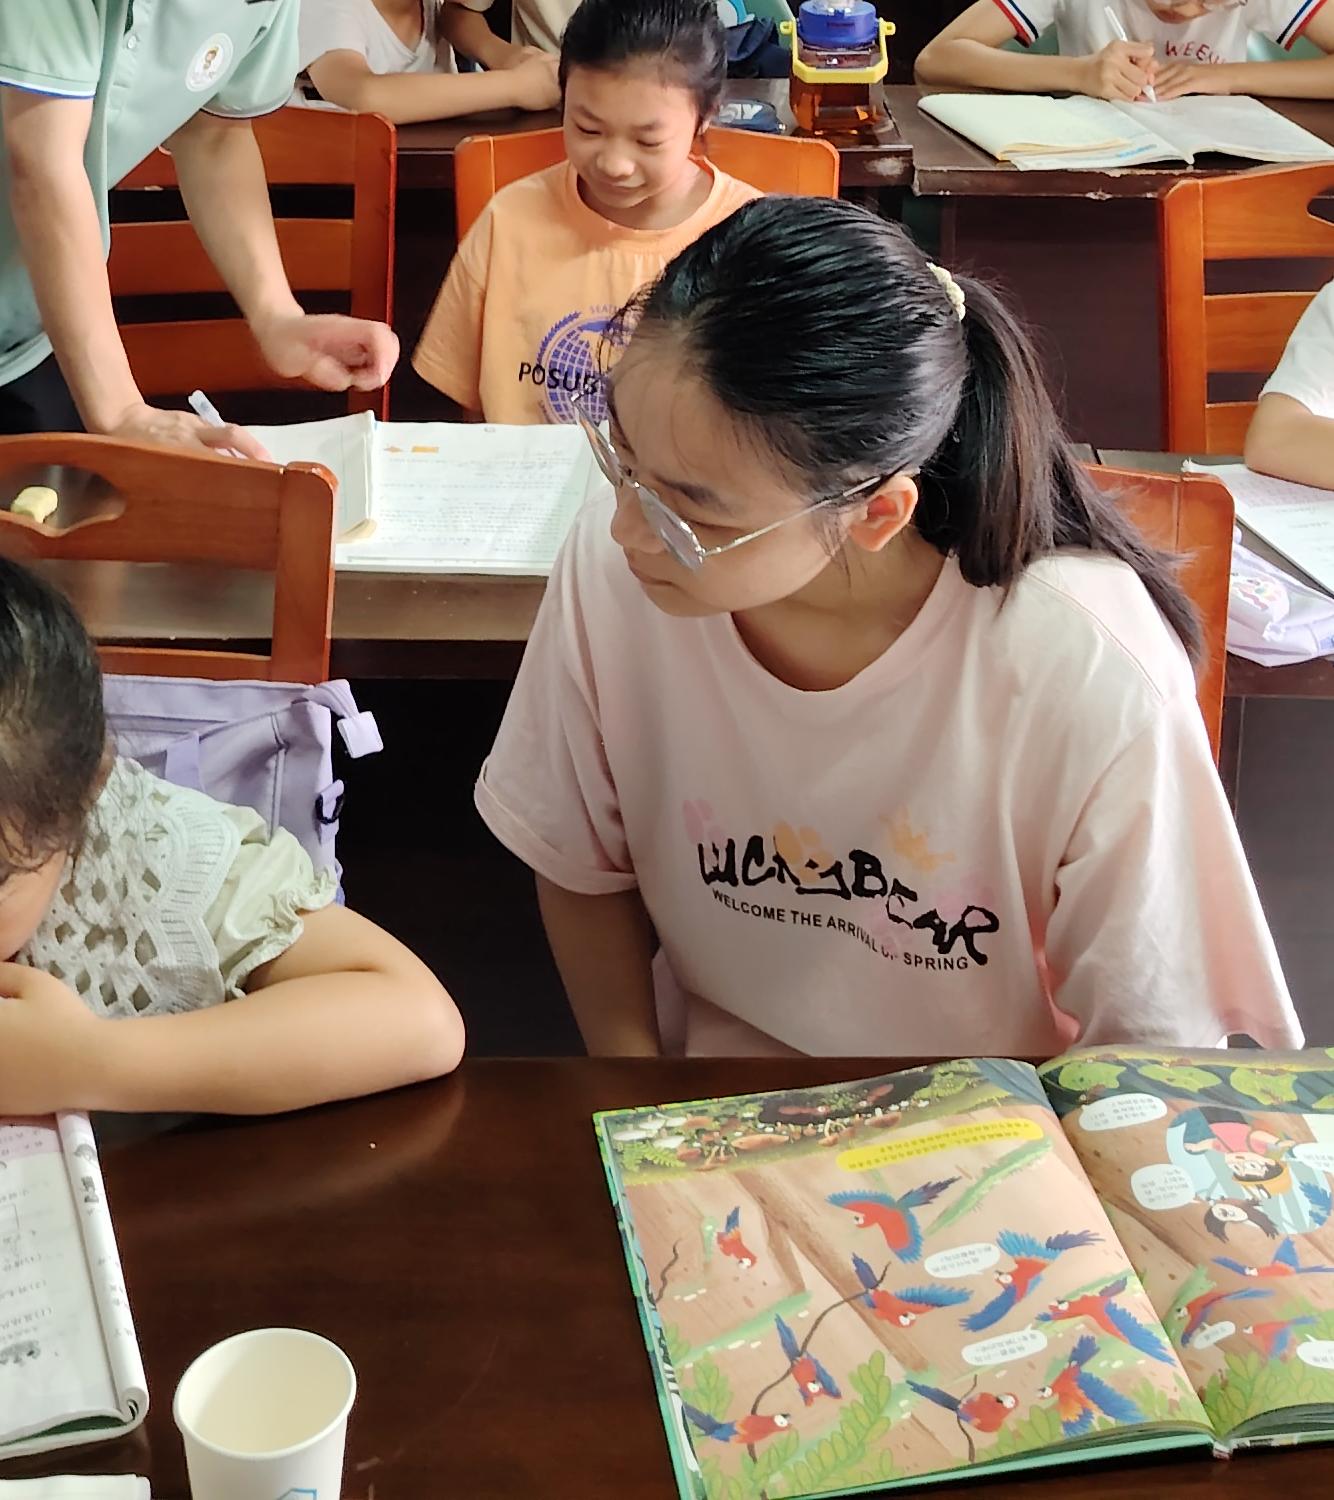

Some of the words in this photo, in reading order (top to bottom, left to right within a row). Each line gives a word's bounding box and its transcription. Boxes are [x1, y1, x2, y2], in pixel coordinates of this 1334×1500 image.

[711, 887, 786, 924] WELCOME
[790, 910, 823, 928] THE
[826, 915, 880, 954] ARRIVAL
[903, 951, 969, 971] SPRING
